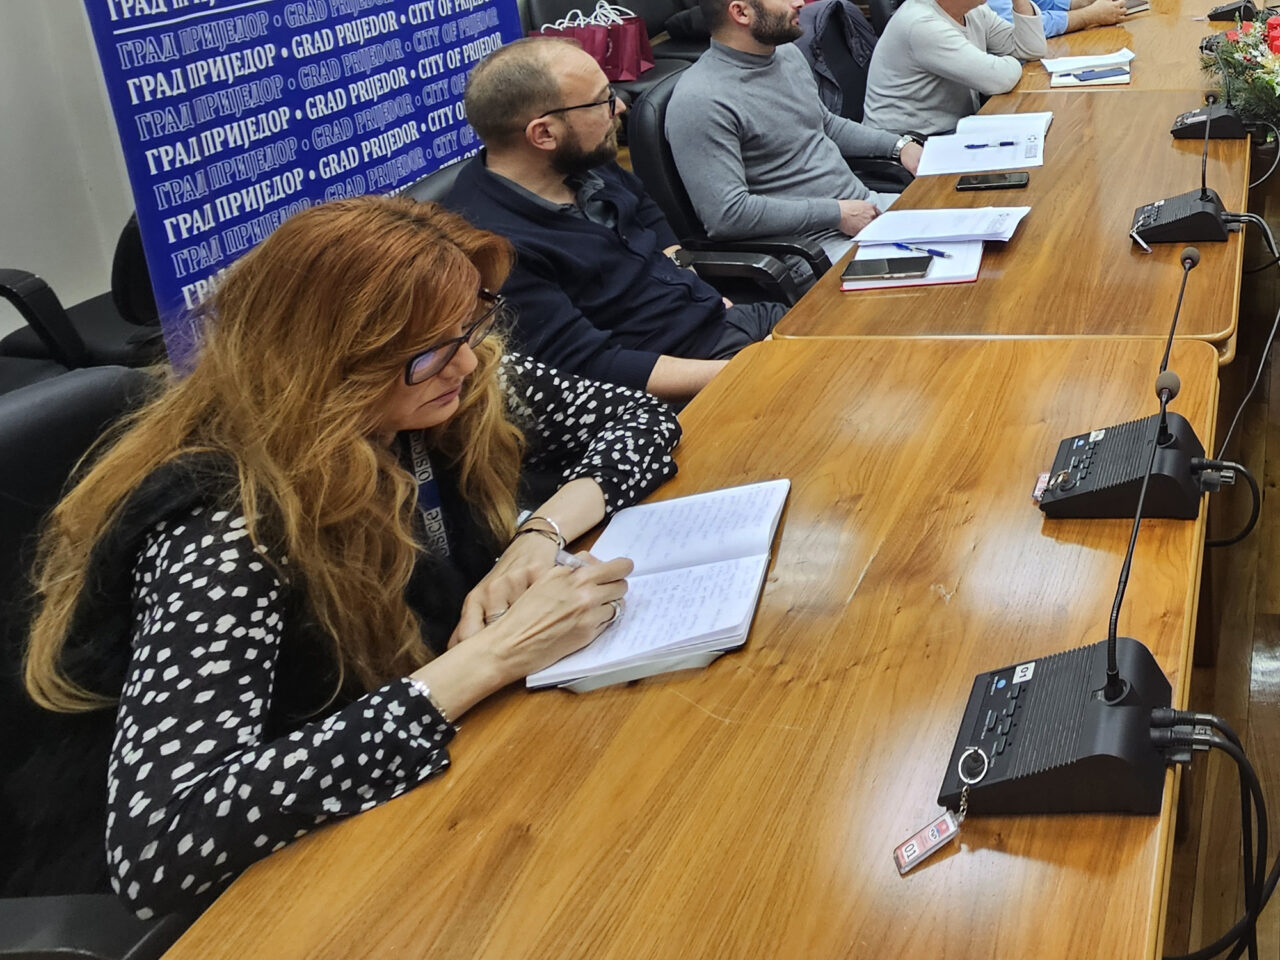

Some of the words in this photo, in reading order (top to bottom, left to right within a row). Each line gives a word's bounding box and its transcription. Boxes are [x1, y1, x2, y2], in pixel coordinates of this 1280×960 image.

[116, 33, 179, 70] ГРАД
[179, 11, 269, 53] ПРИЈЕДОР
[126, 68, 187, 105] ГРАД
[186, 43, 276, 88] ПРИЈЕДОР
[291, 28, 334, 59] GRAD
[335, 10, 399, 46] PRIJEDOR
[408, 0, 435, 25] CITY
[135, 102, 194, 141] ГРАД
[193, 74, 284, 123] ПРИЈЕДОР
[297, 58, 341, 90] GRAD
[341, 38, 404, 76] PRIJEDOR
[413, 26, 440, 53] CITY
[441, 23, 457, 44] OF
[145, 137, 201, 175] ГРАД
[200, 106, 290, 156] ПРИЈЕДОР
[305, 88, 347, 120] GRAD
[348, 66, 409, 105] PRIJEDOR
[418, 54, 444, 79] CITY
[446, 49, 461, 69] OF
[153, 170, 208, 211] ГРАД
[207, 137, 297, 190] ПРИЈЕДОР
[312, 116, 353, 150] GRAD
[353, 93, 415, 134] PRIJEDOR
[422, 79, 449, 106] CITY
[163, 204, 216, 244] ГРАД
[215, 167, 304, 222] ПРИЈЕДОР
[319, 146, 359, 179] GRAD
[361, 121, 419, 162] PRIJEDOR
[428, 105, 454, 132] CITY
[171, 235, 223, 278] ГРАД
[366, 147, 426, 190] PRIJEDOR
[433, 130, 458, 158] CITY
[1018, 666, 1029, 679] 01
[904, 843, 917, 860] 01
